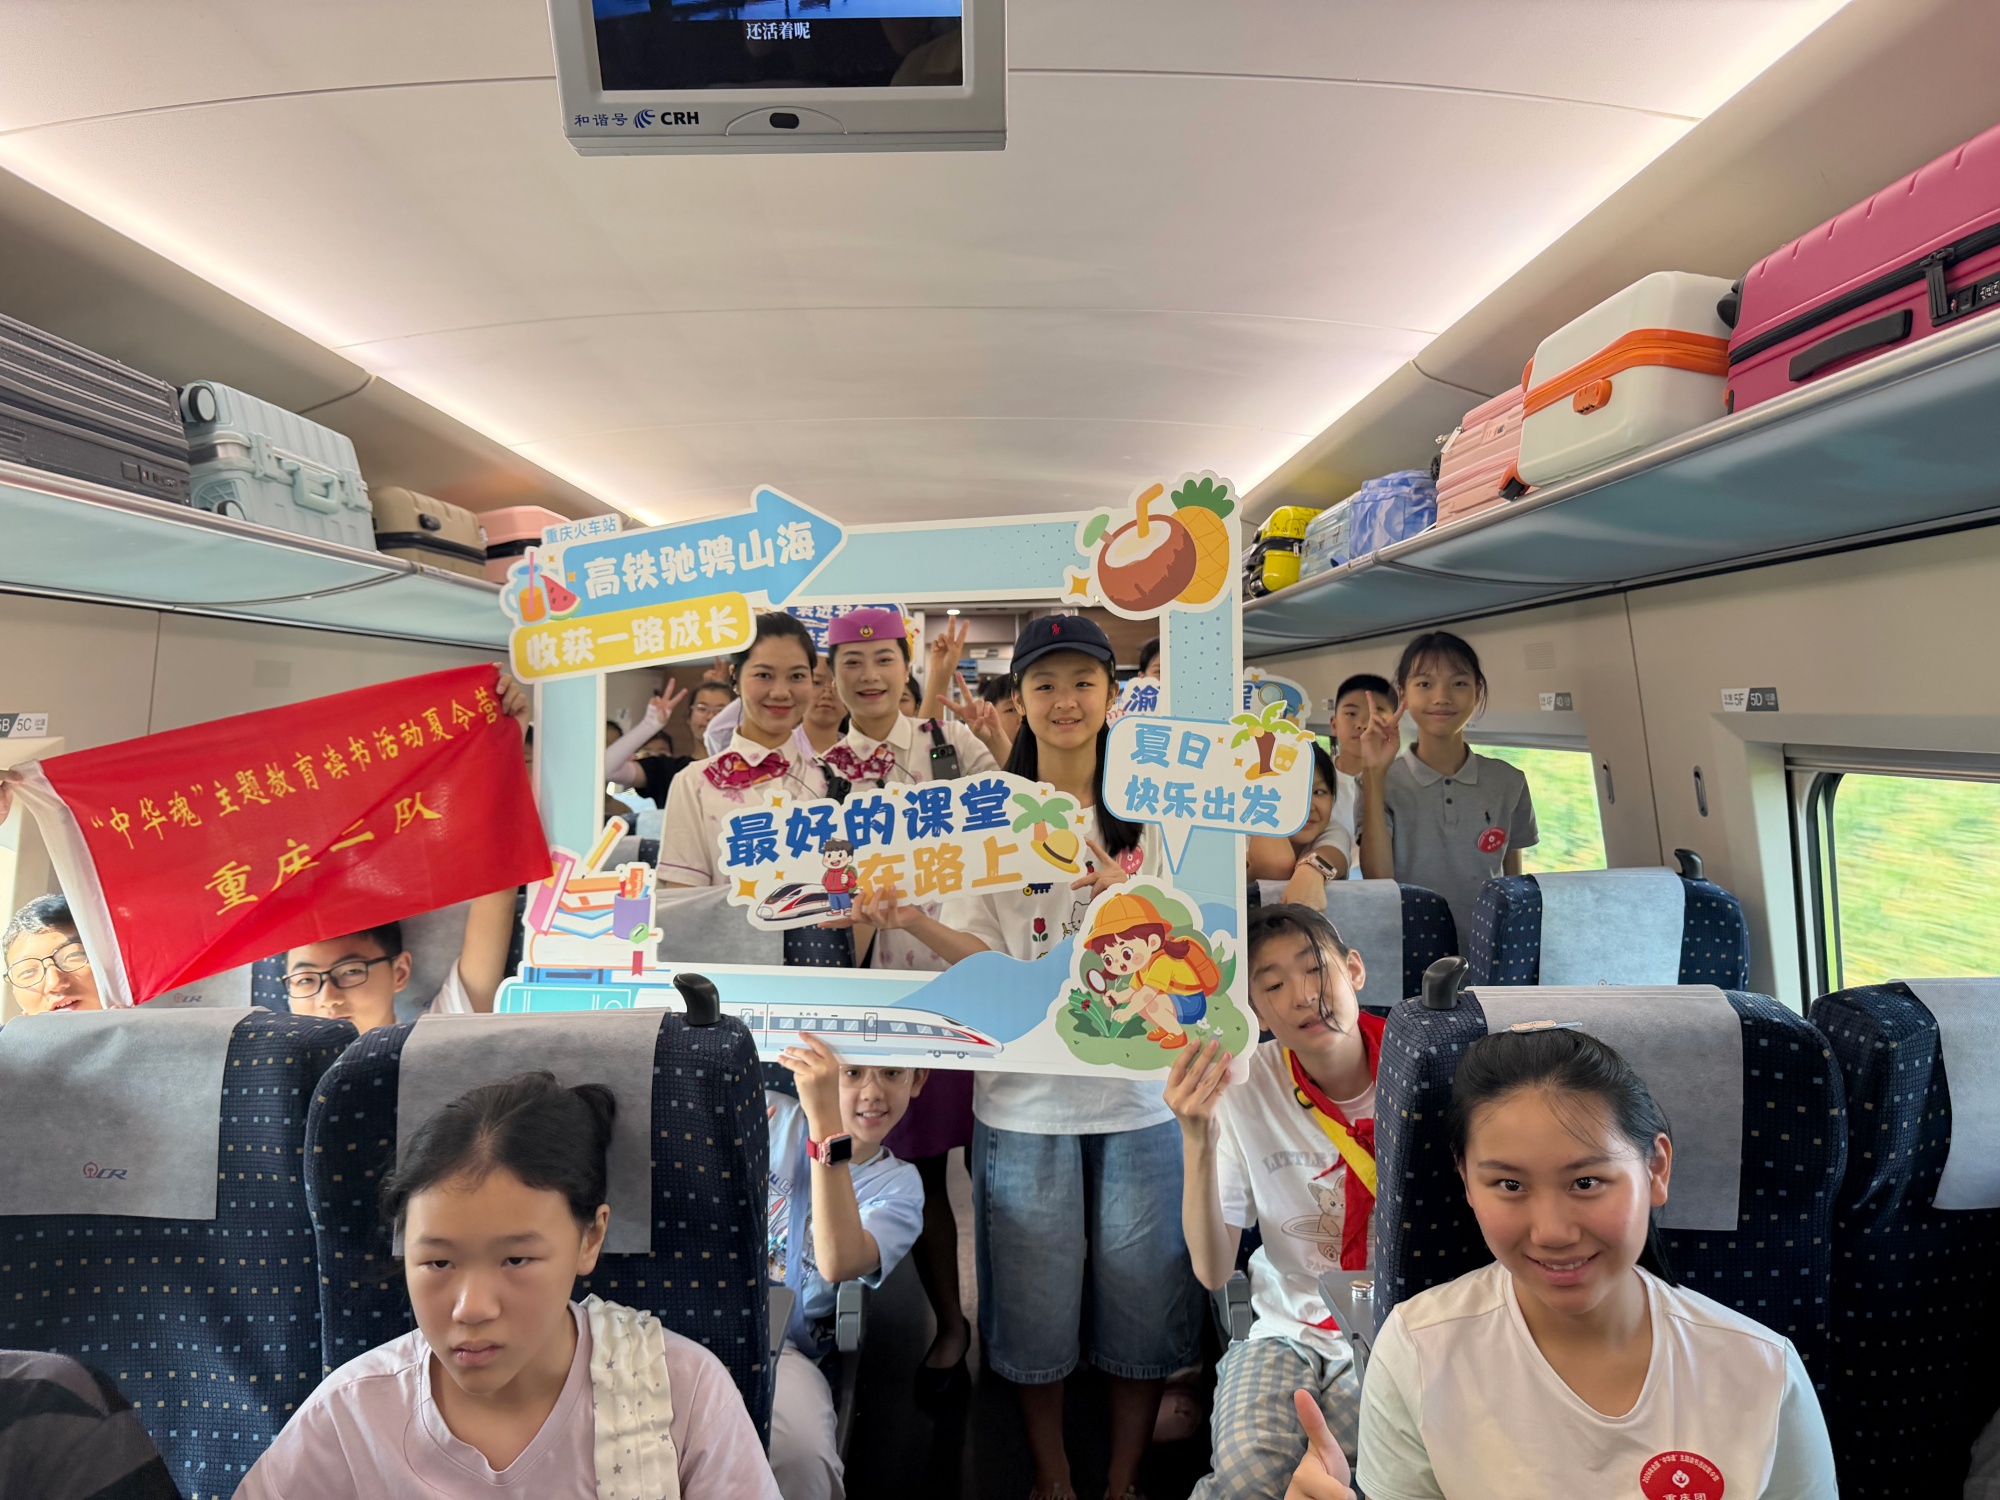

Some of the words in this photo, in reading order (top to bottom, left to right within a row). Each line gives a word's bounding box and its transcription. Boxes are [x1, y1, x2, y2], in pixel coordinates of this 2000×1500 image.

[746, 22, 811, 40] 还活着呢
[574, 114, 628, 128] 和谐号
[660, 111, 699, 126] CRH
[545, 516, 617, 544] 重庆火车站
[584, 521, 816, 599] 高铁驰骋山海
[525, 605, 739, 671] 收获一路成长
[1750, 692, 1762, 706] 5D
[0, 718, 10, 731] B
[16, 717, 32, 731] 5C
[1130, 723, 1211, 769] 夏日
[1124, 774, 1282, 828] 快乐出发
[725, 778, 1011, 868] 最好的课堂
[856, 836, 1023, 906] 在路上
